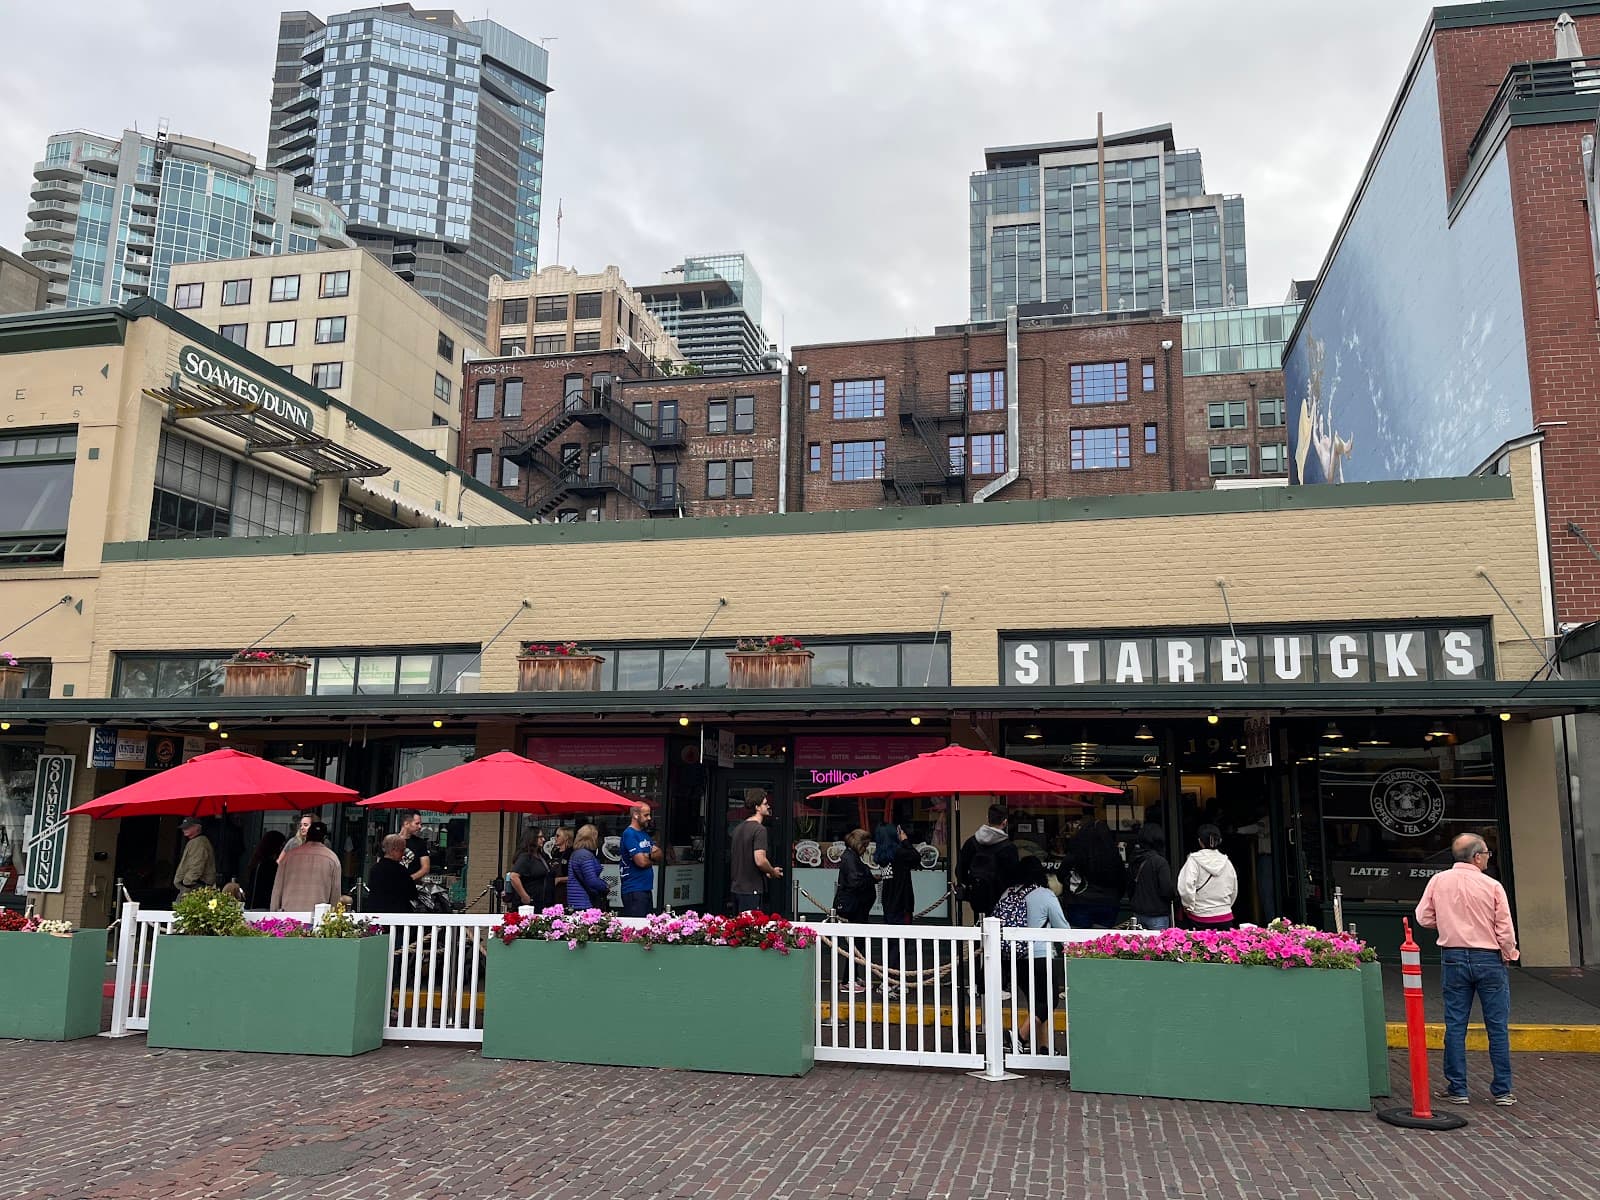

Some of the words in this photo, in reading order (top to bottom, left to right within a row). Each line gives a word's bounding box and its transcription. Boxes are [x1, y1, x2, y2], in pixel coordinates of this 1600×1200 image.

[185, 353, 308, 428] SOAMES/DUNN
[1014, 631, 1474, 684] STARBUCKS
[1383, 771, 1430, 785] STARBUCKS
[46, 759, 61, 828] SOAMES
[1374, 797, 1394, 826] COFFEE
[1427, 798, 1441, 824] SPICES
[1403, 824, 1420, 833] TEA
[37, 839, 54, 886] DUNN
[1350, 867, 1389, 876] LATTE
